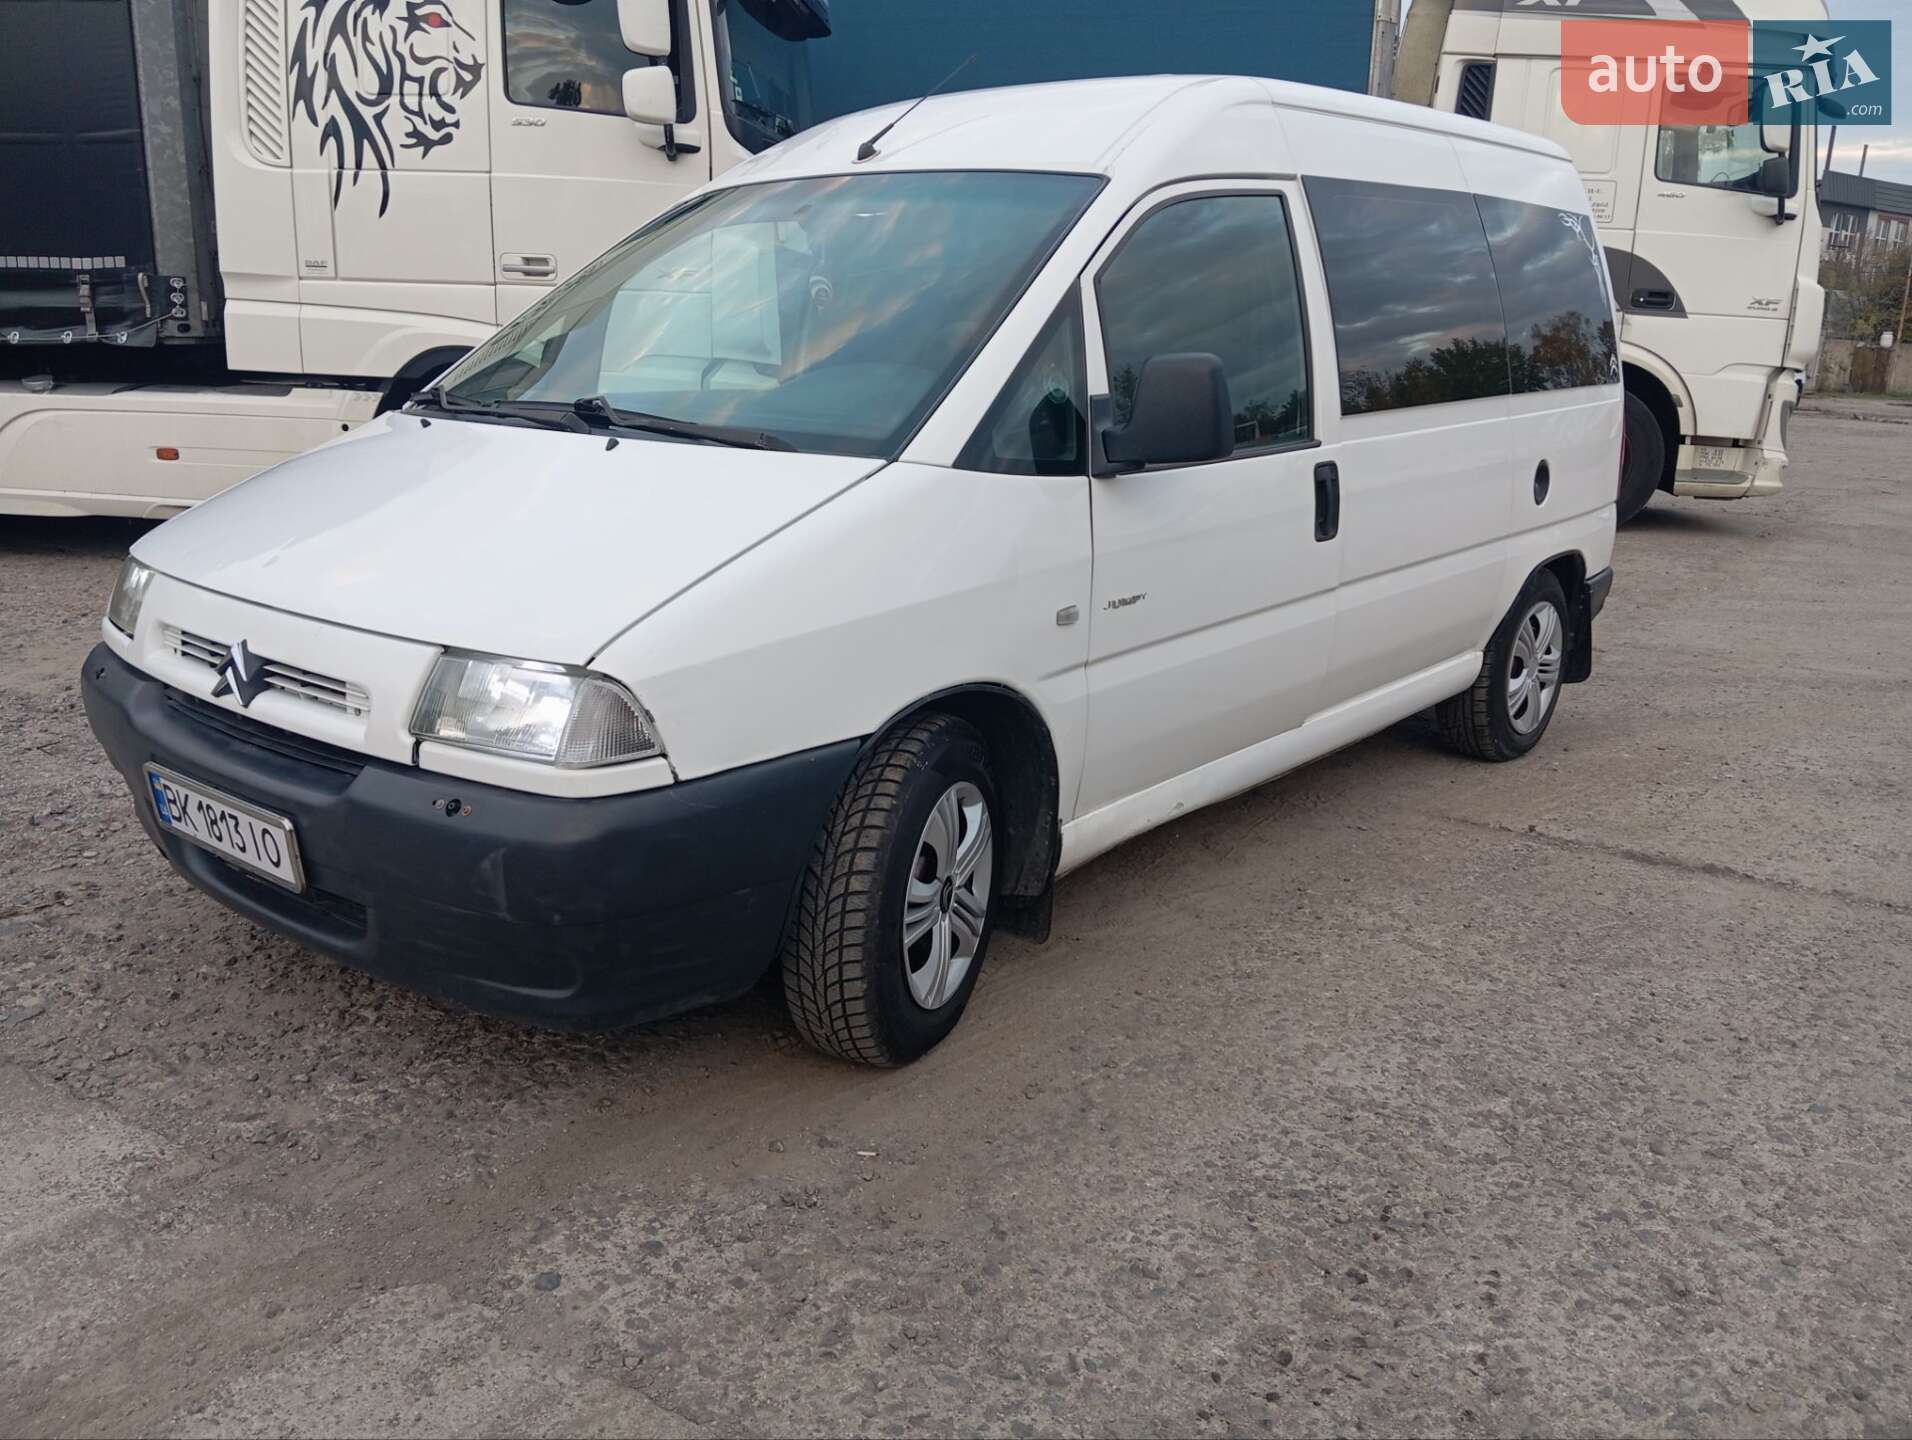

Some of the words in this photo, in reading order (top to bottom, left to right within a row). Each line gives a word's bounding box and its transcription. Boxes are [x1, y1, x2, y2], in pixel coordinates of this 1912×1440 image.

[1103, 592, 1148, 611] JUMPY
[163, 783, 198, 832] BK
[196, 800, 246, 853] 1813
